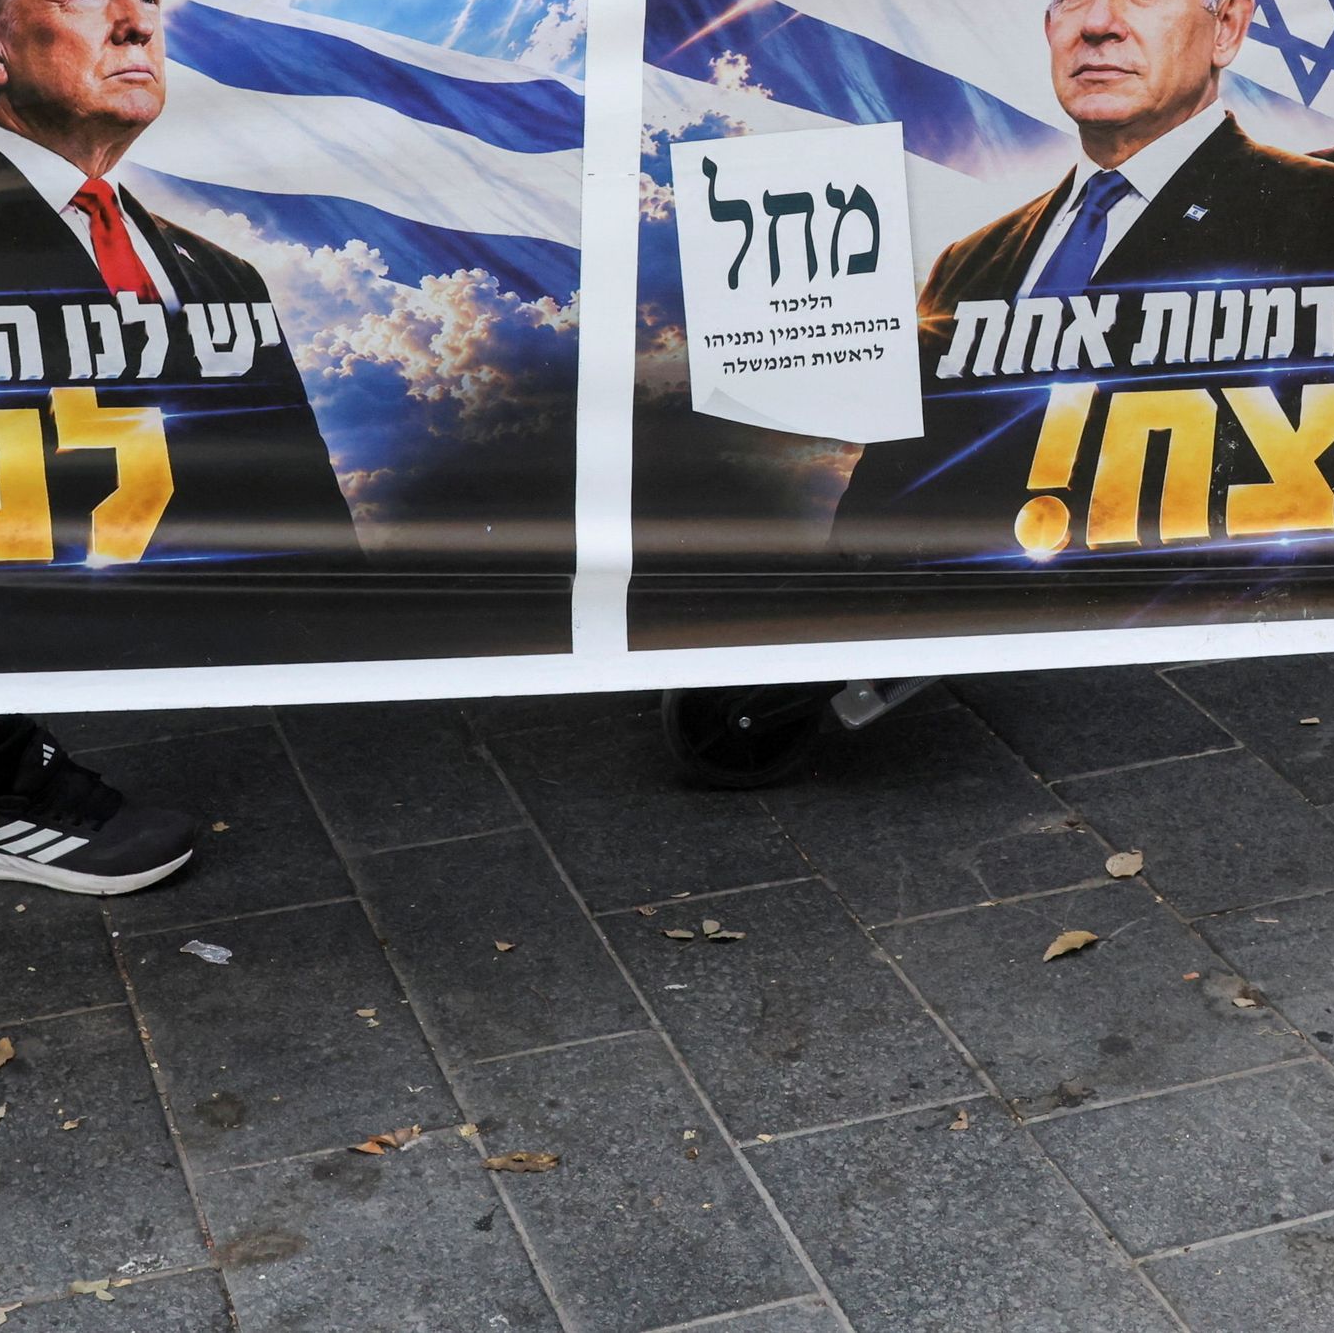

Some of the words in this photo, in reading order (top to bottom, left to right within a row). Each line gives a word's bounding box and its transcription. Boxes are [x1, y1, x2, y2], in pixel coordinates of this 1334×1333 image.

[701, 155, 881, 291] מחל
[769, 293, 833, 314] הליכוד
[61, 290, 170, 380] לנו
[703, 329, 764, 349] נתניהו
[768, 322, 827, 346] בנימין
[831, 317, 901, 337] בהנהגת
[935, 293, 1121, 380] אחת
[183, 302, 282, 378] יש
[722, 350, 806, 375] הממשלה
[811, 344, 885, 366] לראשות
